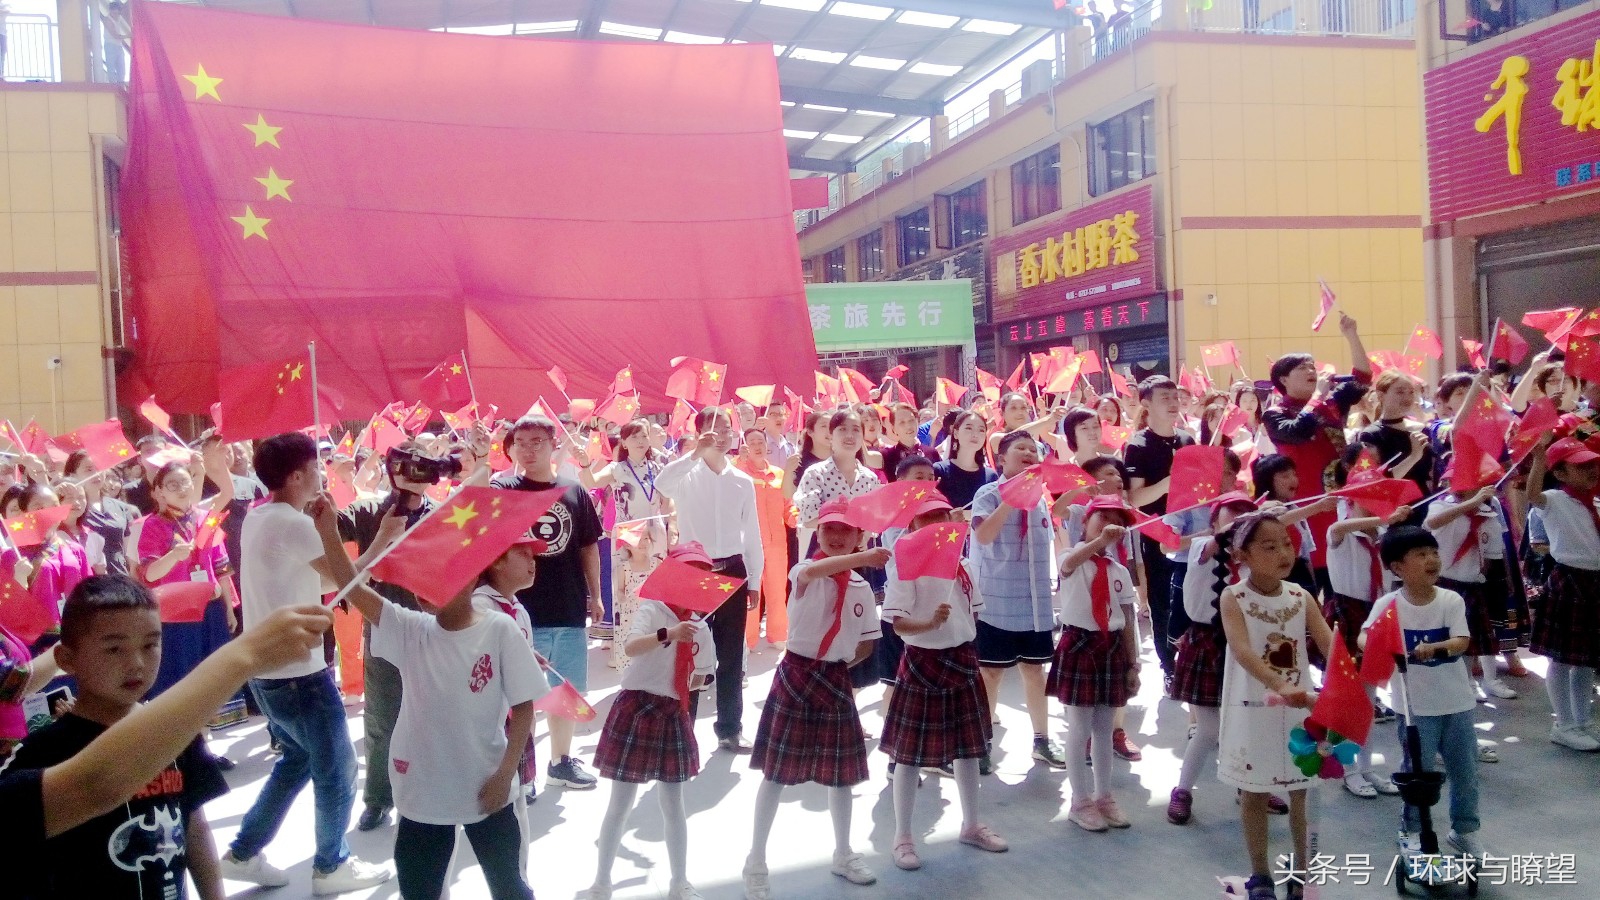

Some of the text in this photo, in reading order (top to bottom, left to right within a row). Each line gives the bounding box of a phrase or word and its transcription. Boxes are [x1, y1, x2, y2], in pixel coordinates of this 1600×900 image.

[1019, 210, 1140, 288] 香水村野茶
[809, 301, 942, 330] 茶旅先行
